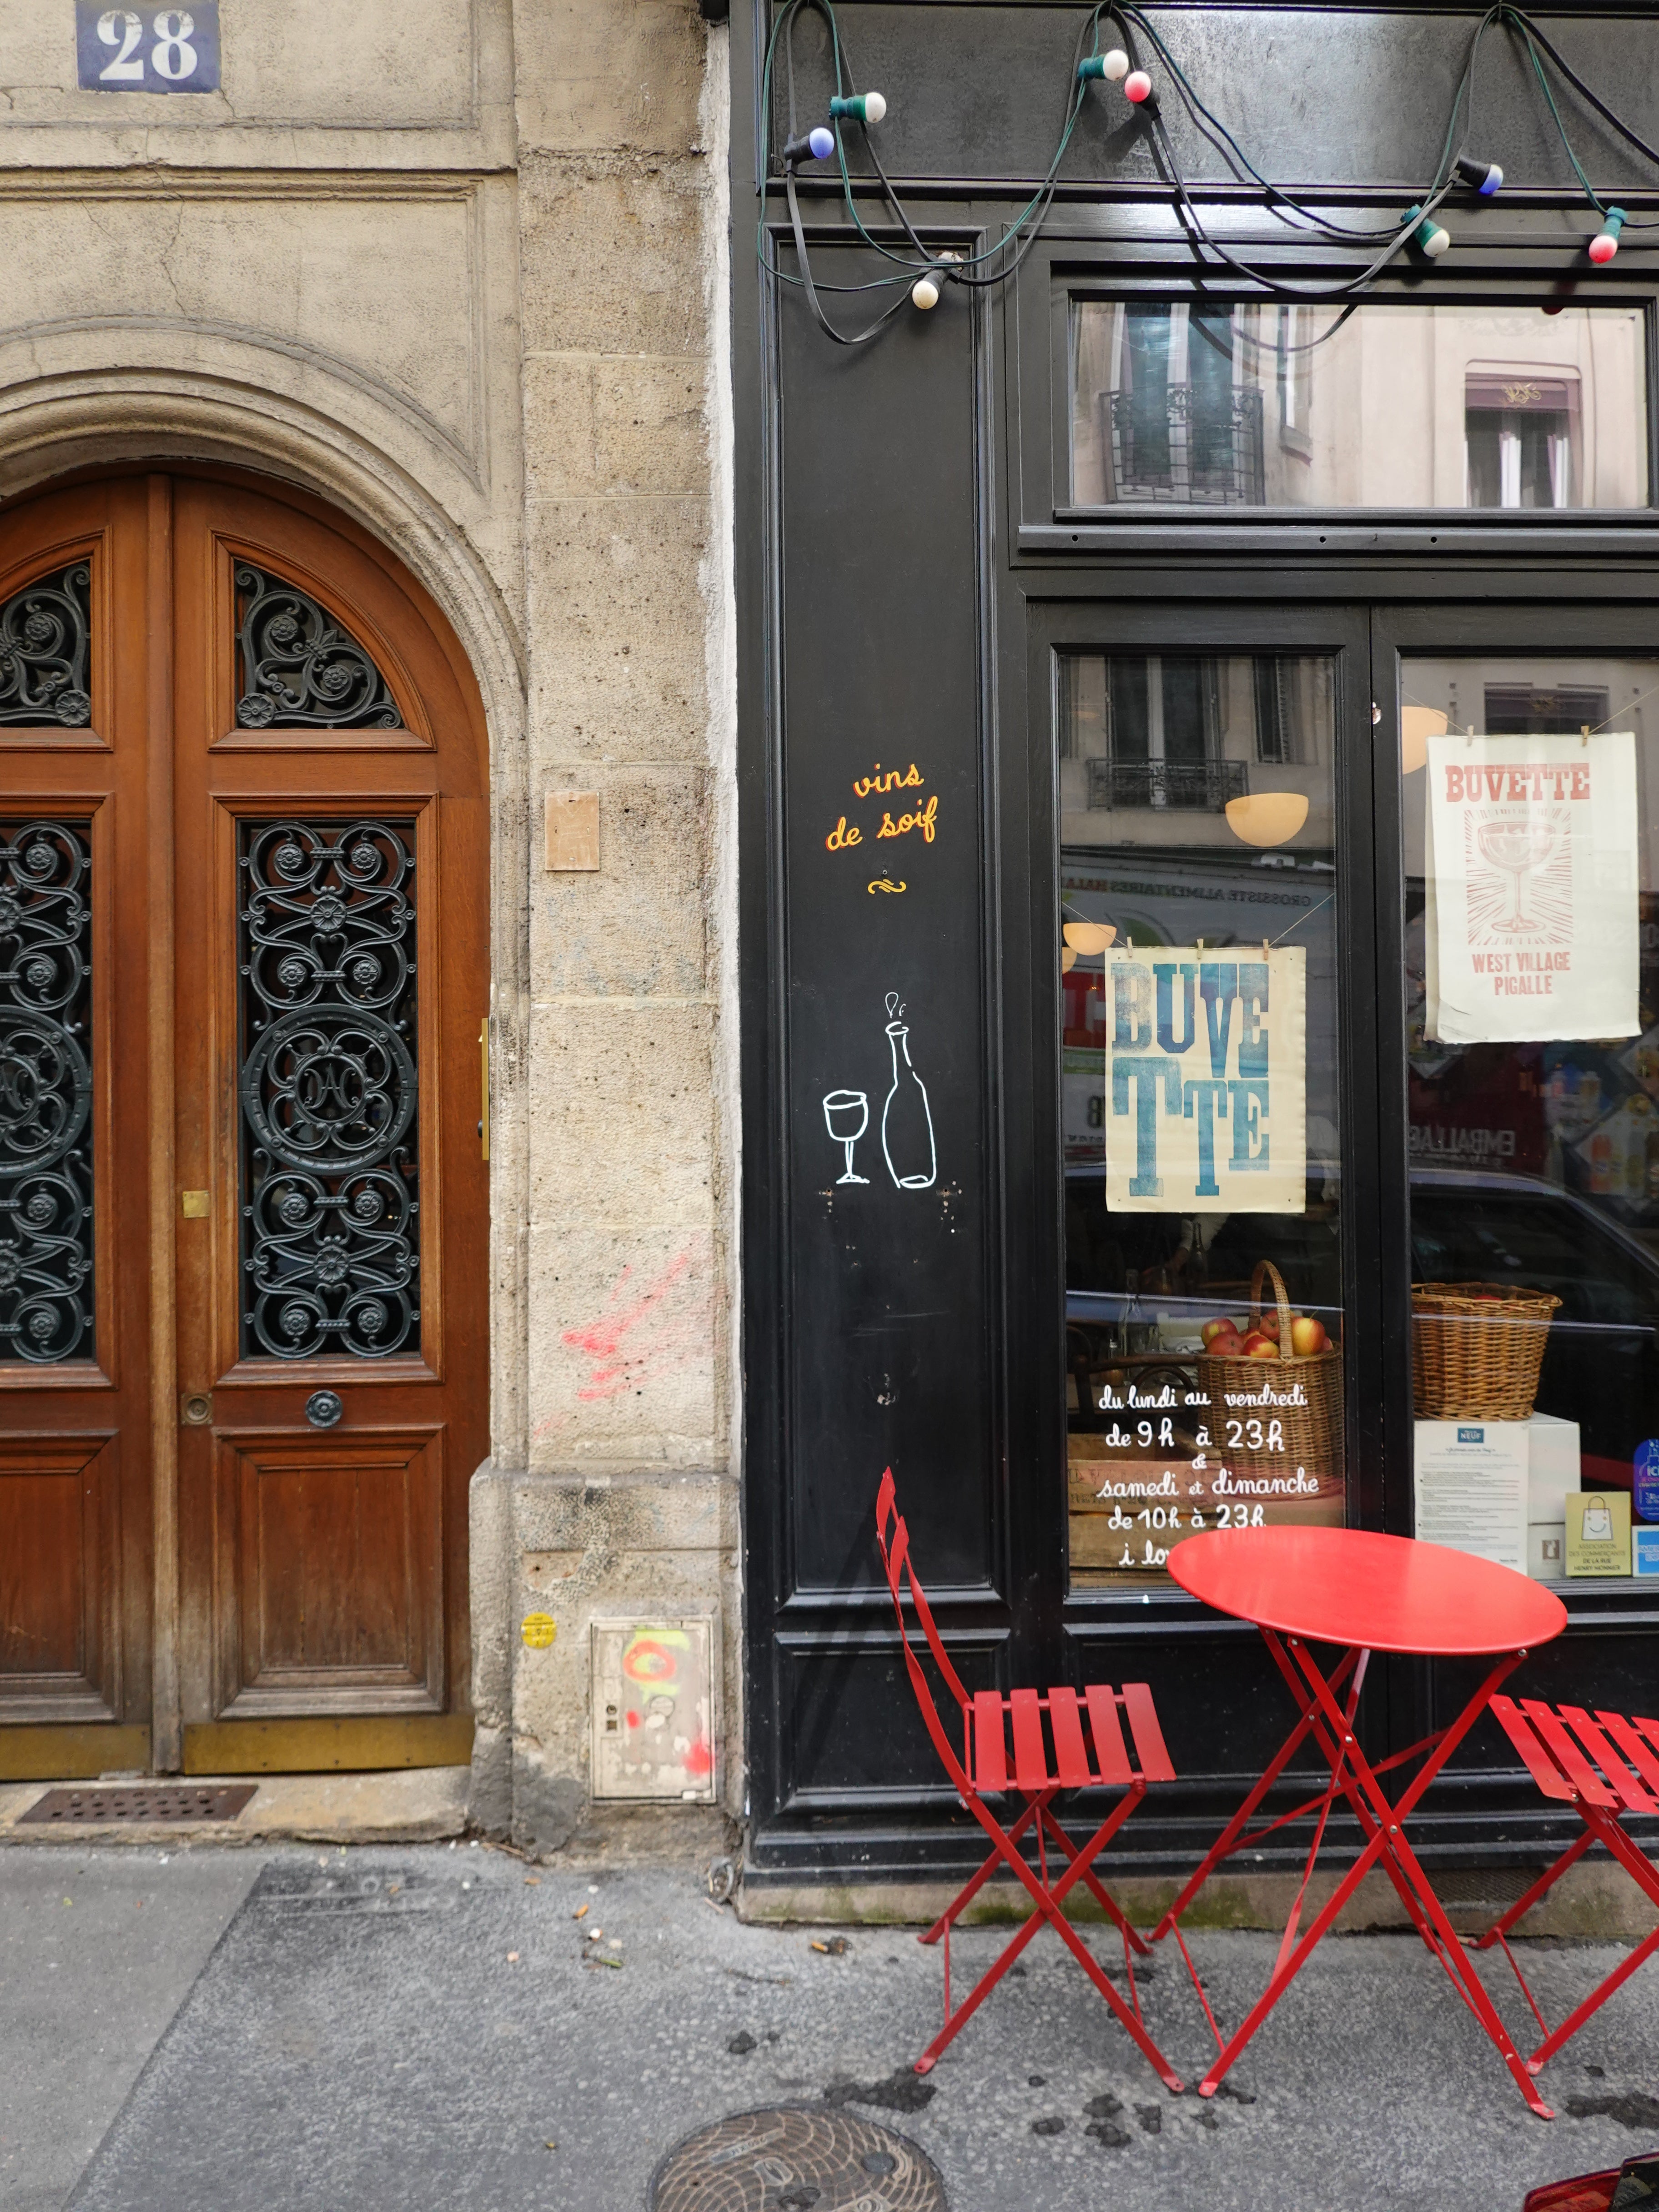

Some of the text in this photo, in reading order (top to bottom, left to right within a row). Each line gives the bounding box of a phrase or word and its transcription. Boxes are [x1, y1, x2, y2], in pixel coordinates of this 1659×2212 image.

[96, 9, 198, 81] 28
[853, 763, 925, 799] vins
[1445, 763, 1590, 802] BUVETTE
[825, 795, 938, 851] de soif
[1472, 951, 1571, 973] WEST VILLAGE
[1494, 975, 1553, 996] PIGALLE
[1111, 962, 1269, 1078] BUVE
[1112, 1056, 1270, 1196] TTE
[1099, 1383, 1308, 1409] du lundi au vendredi
[1106, 1417, 1285, 1452] de 9h à 23h
[1191, 1453, 1207, 1470] &
[1096, 1471, 1180, 1498] samedi
[1188, 1481, 1205, 1495] et
[1212, 1466, 1319, 1495] dimanche
[1108, 1503, 1267, 1530] de 10h à 23h
[1118, 1543, 1135, 1566] i
